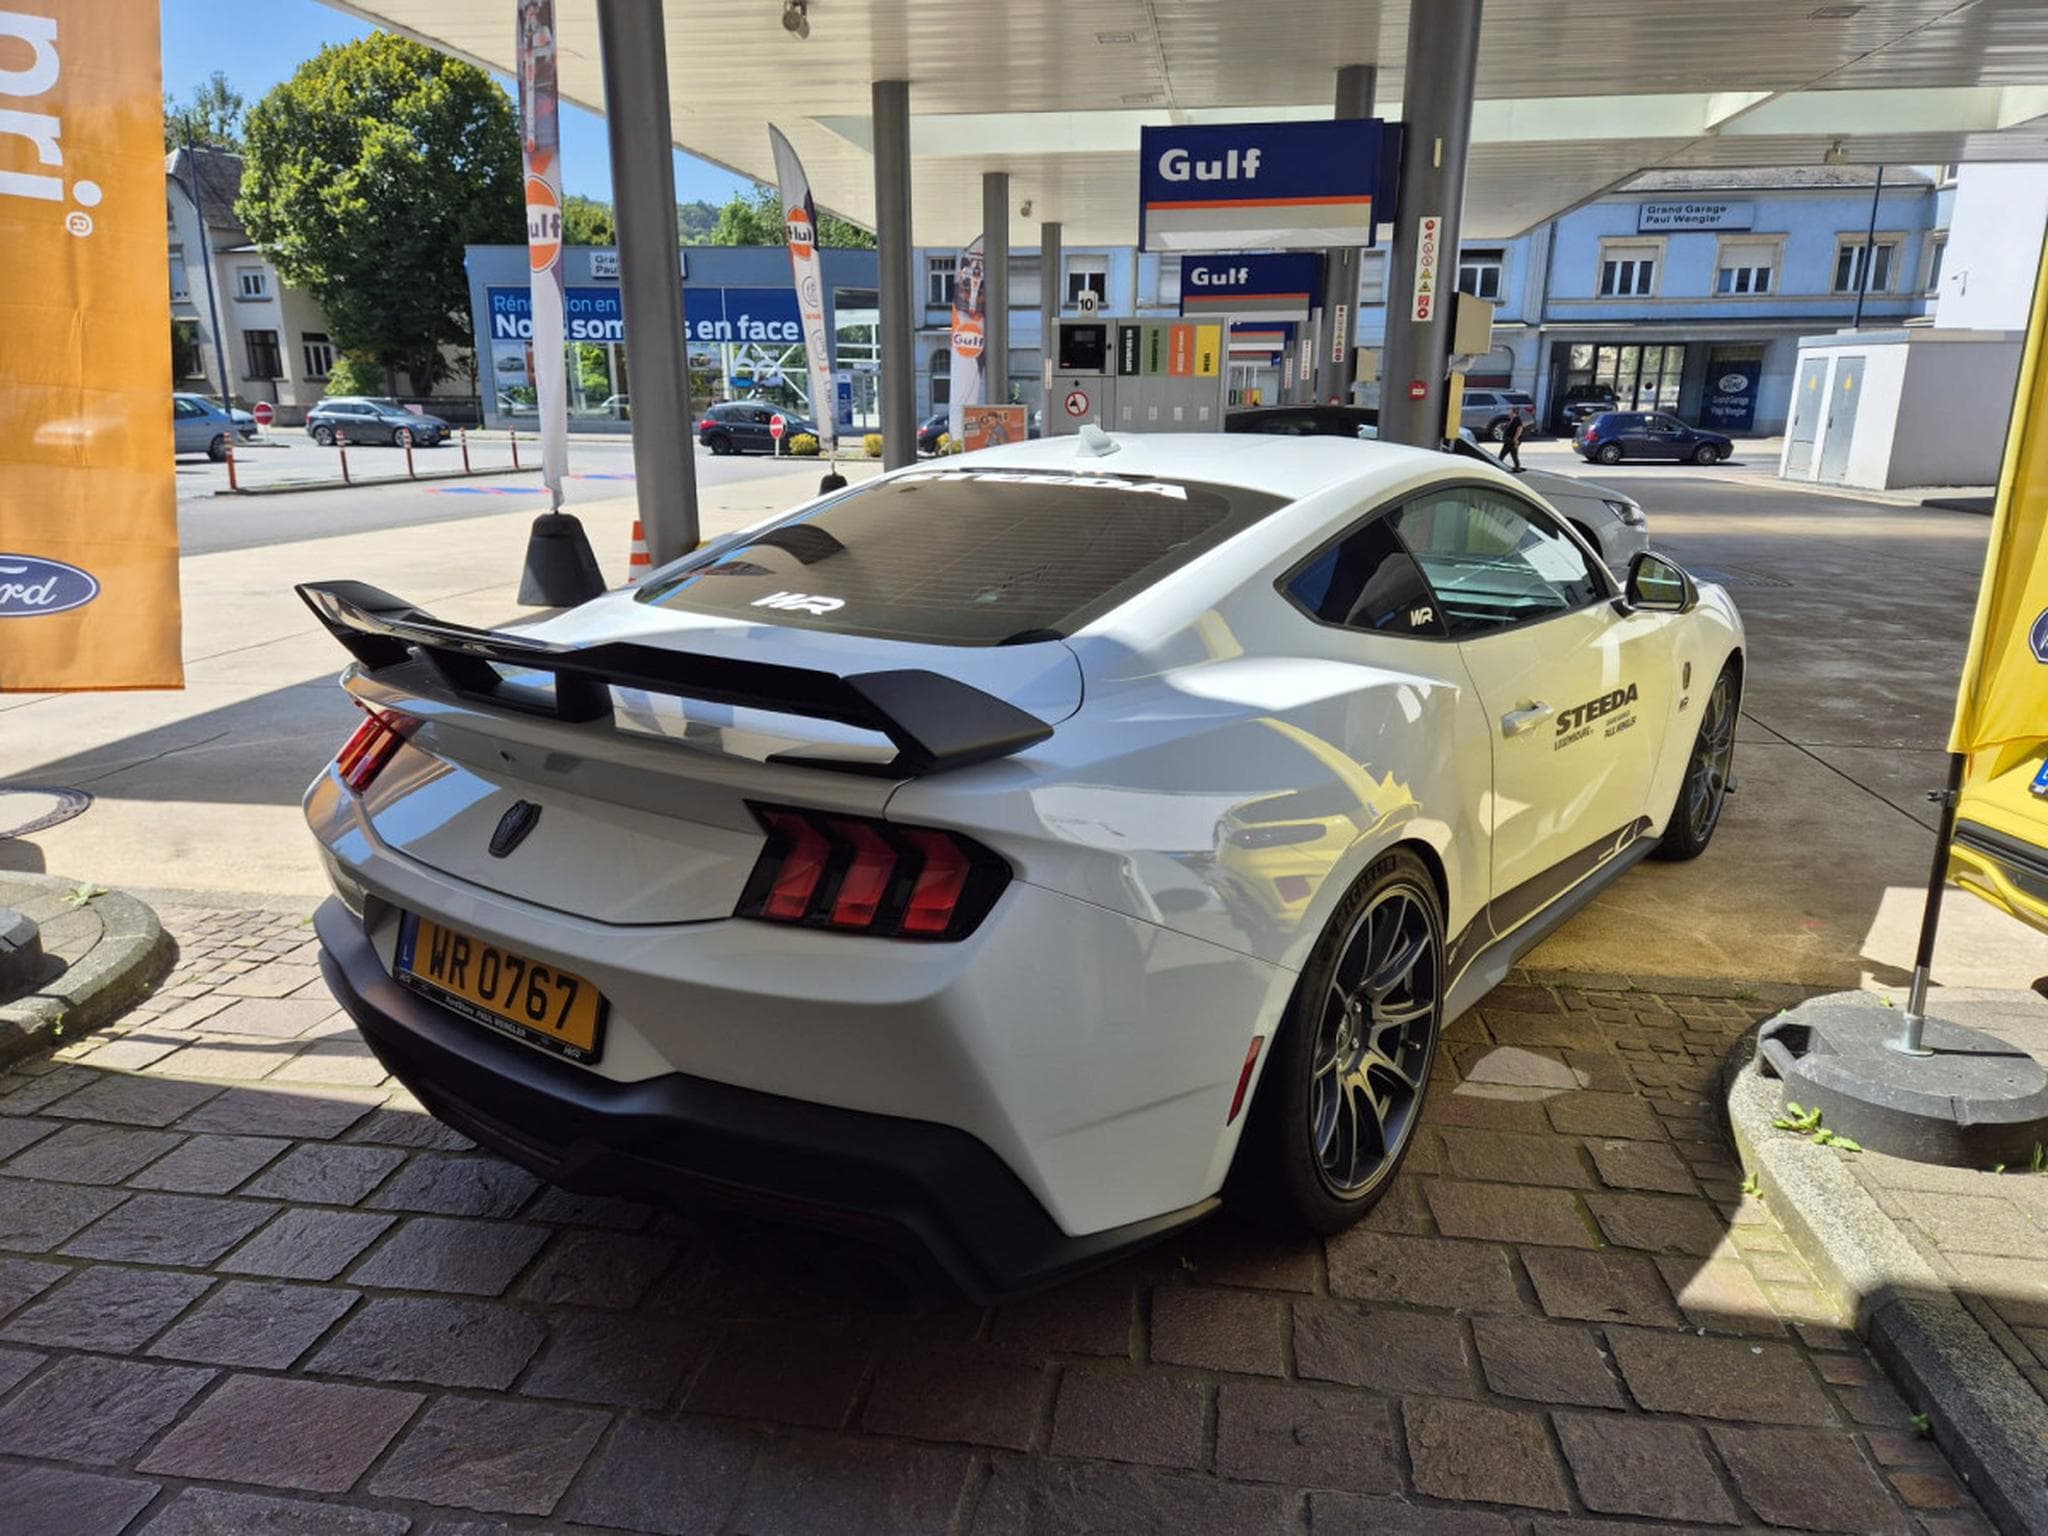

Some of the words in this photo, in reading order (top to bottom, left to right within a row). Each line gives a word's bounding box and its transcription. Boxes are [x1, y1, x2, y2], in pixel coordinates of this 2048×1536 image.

[1158, 148, 1262, 181] Gulf
[1647, 206, 1682, 214] Grand
[1685, 204, 1727, 213] Garage
[529, 213, 560, 239] ulf
[1646, 215, 1670, 223] Paul
[1673, 214, 1721, 224] Wengler
[594, 255, 618, 264] Gra
[595, 265, 618, 274] Pau
[1191, 267, 1249, 285] Gulf
[595, 299, 617, 312] en
[1079, 298, 1093, 311] 10
[697, 321, 732, 339] en
[737, 314, 799, 340] face
[953, 333, 984, 347] Gulf
[750, 591, 845, 615] WR
[1410, 606, 1433, 627] WR
[1555, 682, 1638, 737] STEEDA
[429, 924, 472, 990] WR
[478, 947, 579, 1030] 0767
